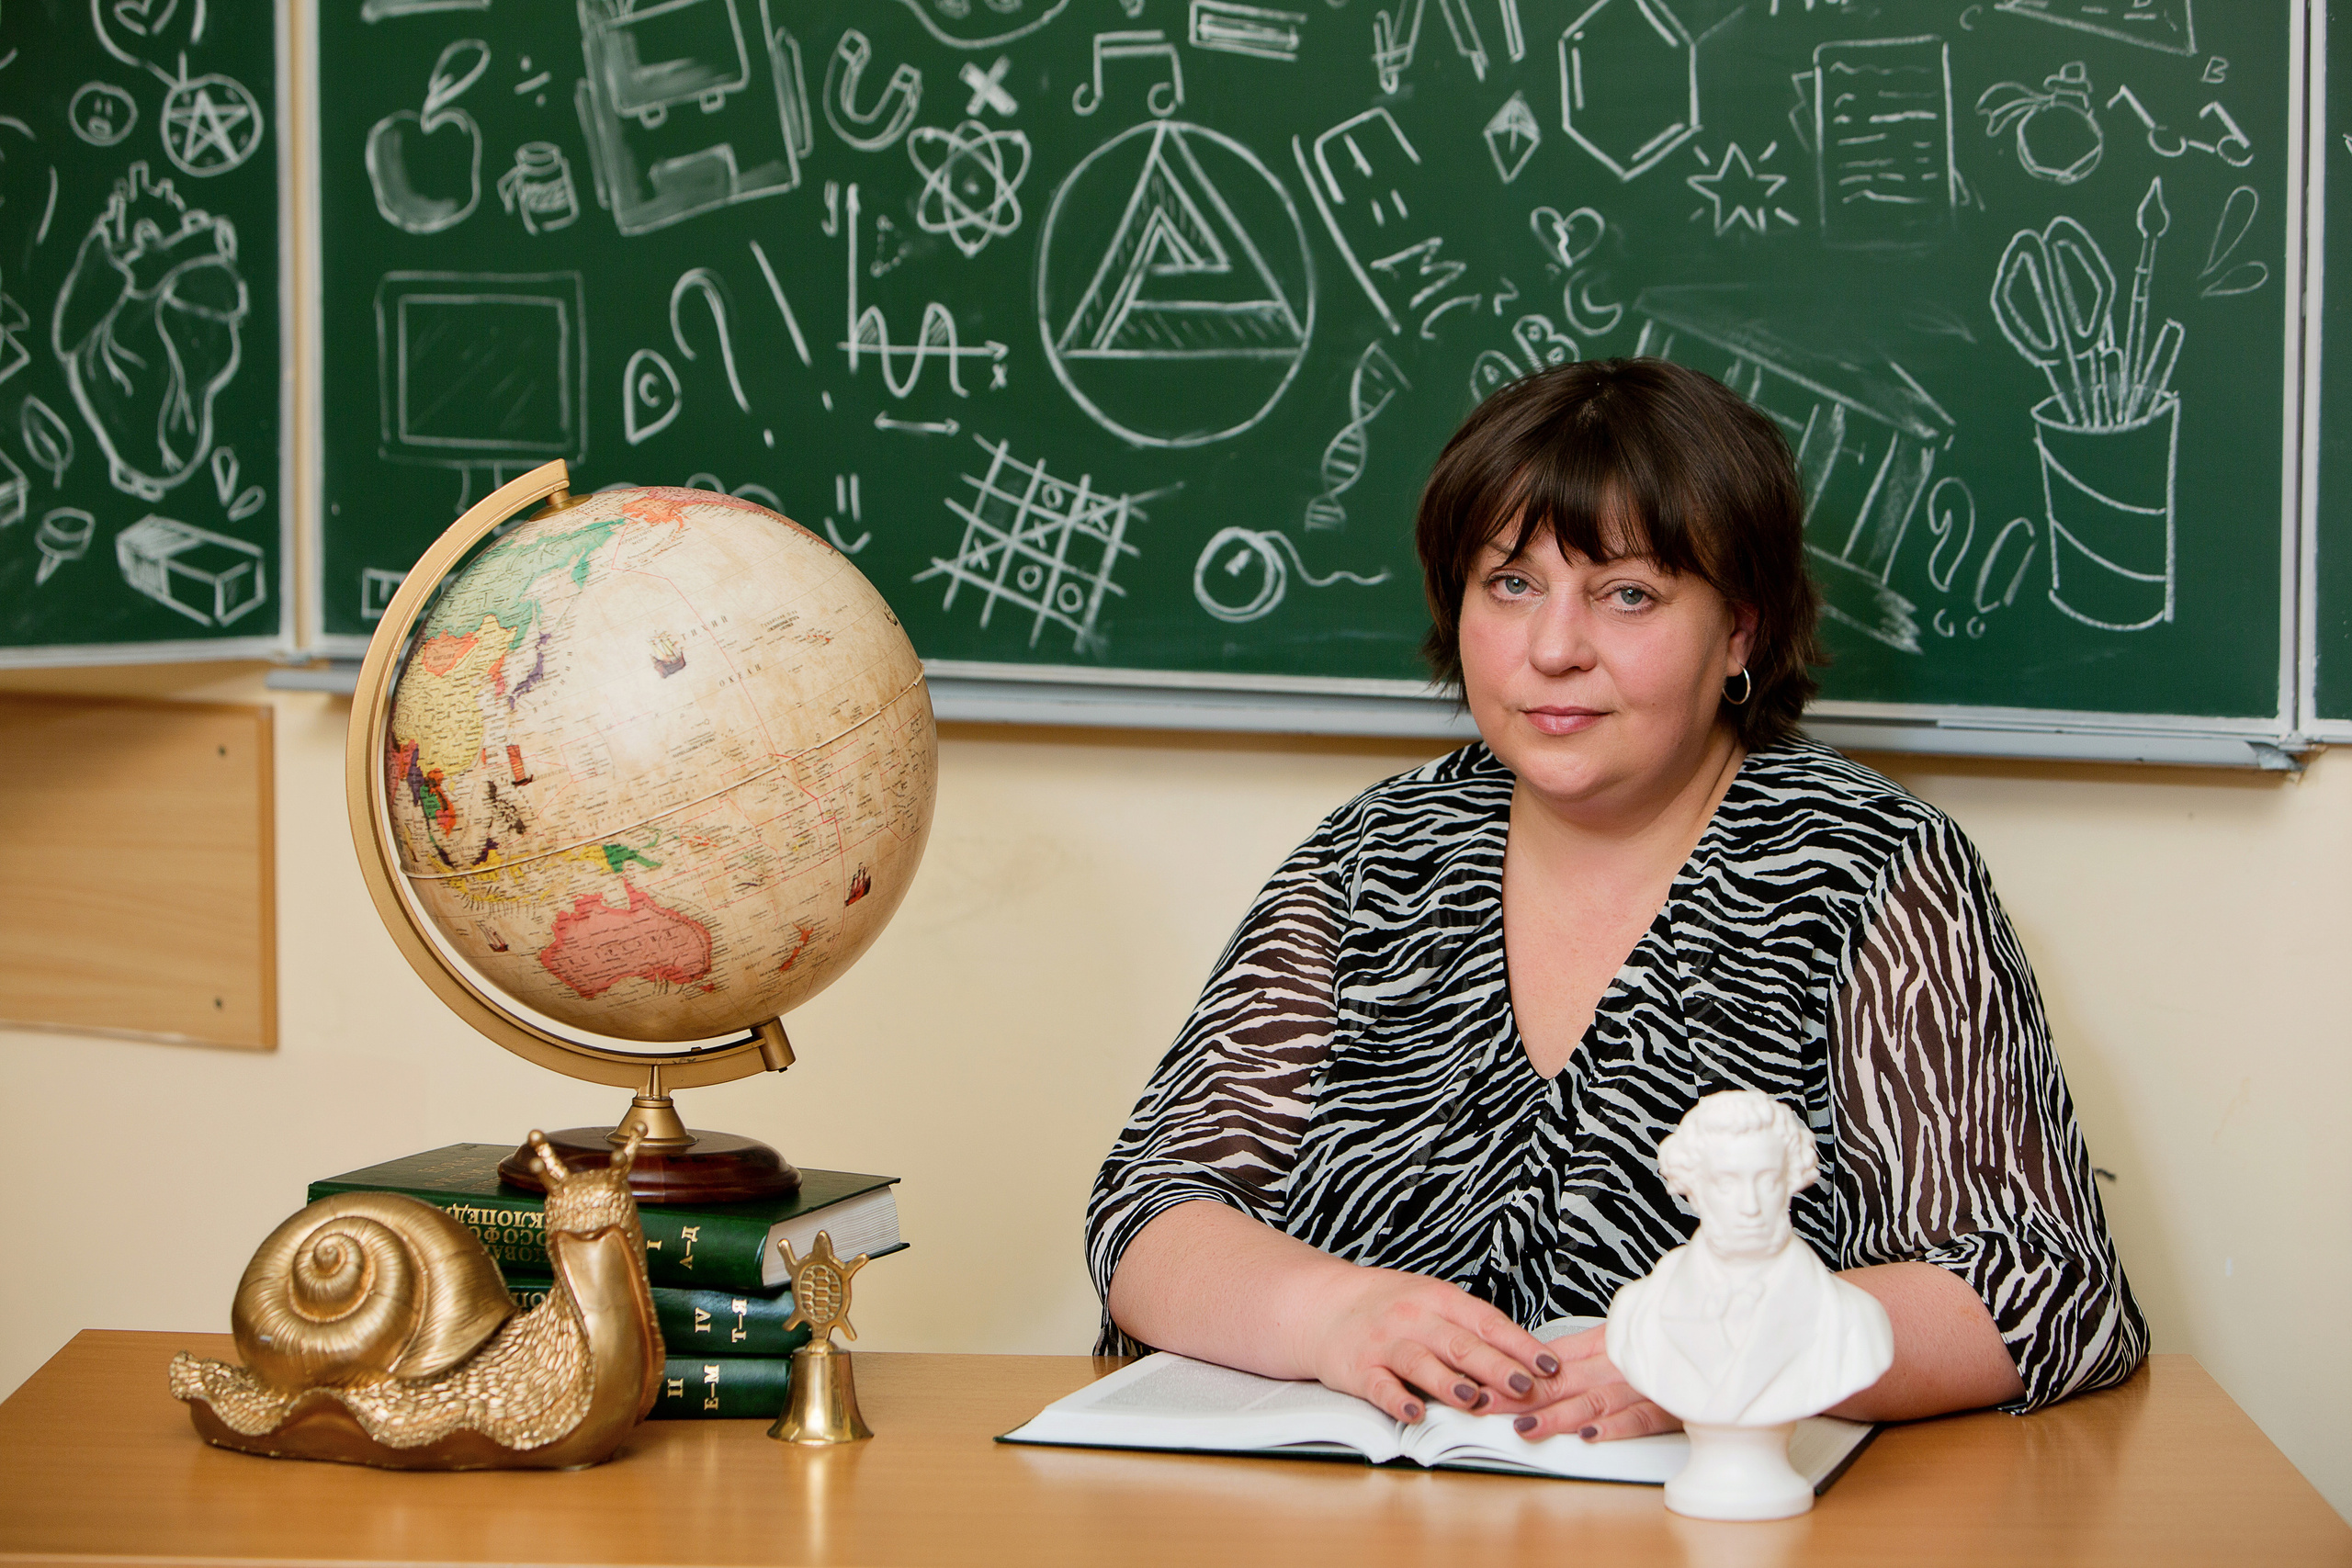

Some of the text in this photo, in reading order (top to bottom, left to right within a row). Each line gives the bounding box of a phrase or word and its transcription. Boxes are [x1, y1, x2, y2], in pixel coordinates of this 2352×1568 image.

[486, 1244, 551, 1263] НОВА
[695, 1306, 712, 1333] IV
[667, 1378, 684, 1398] II
